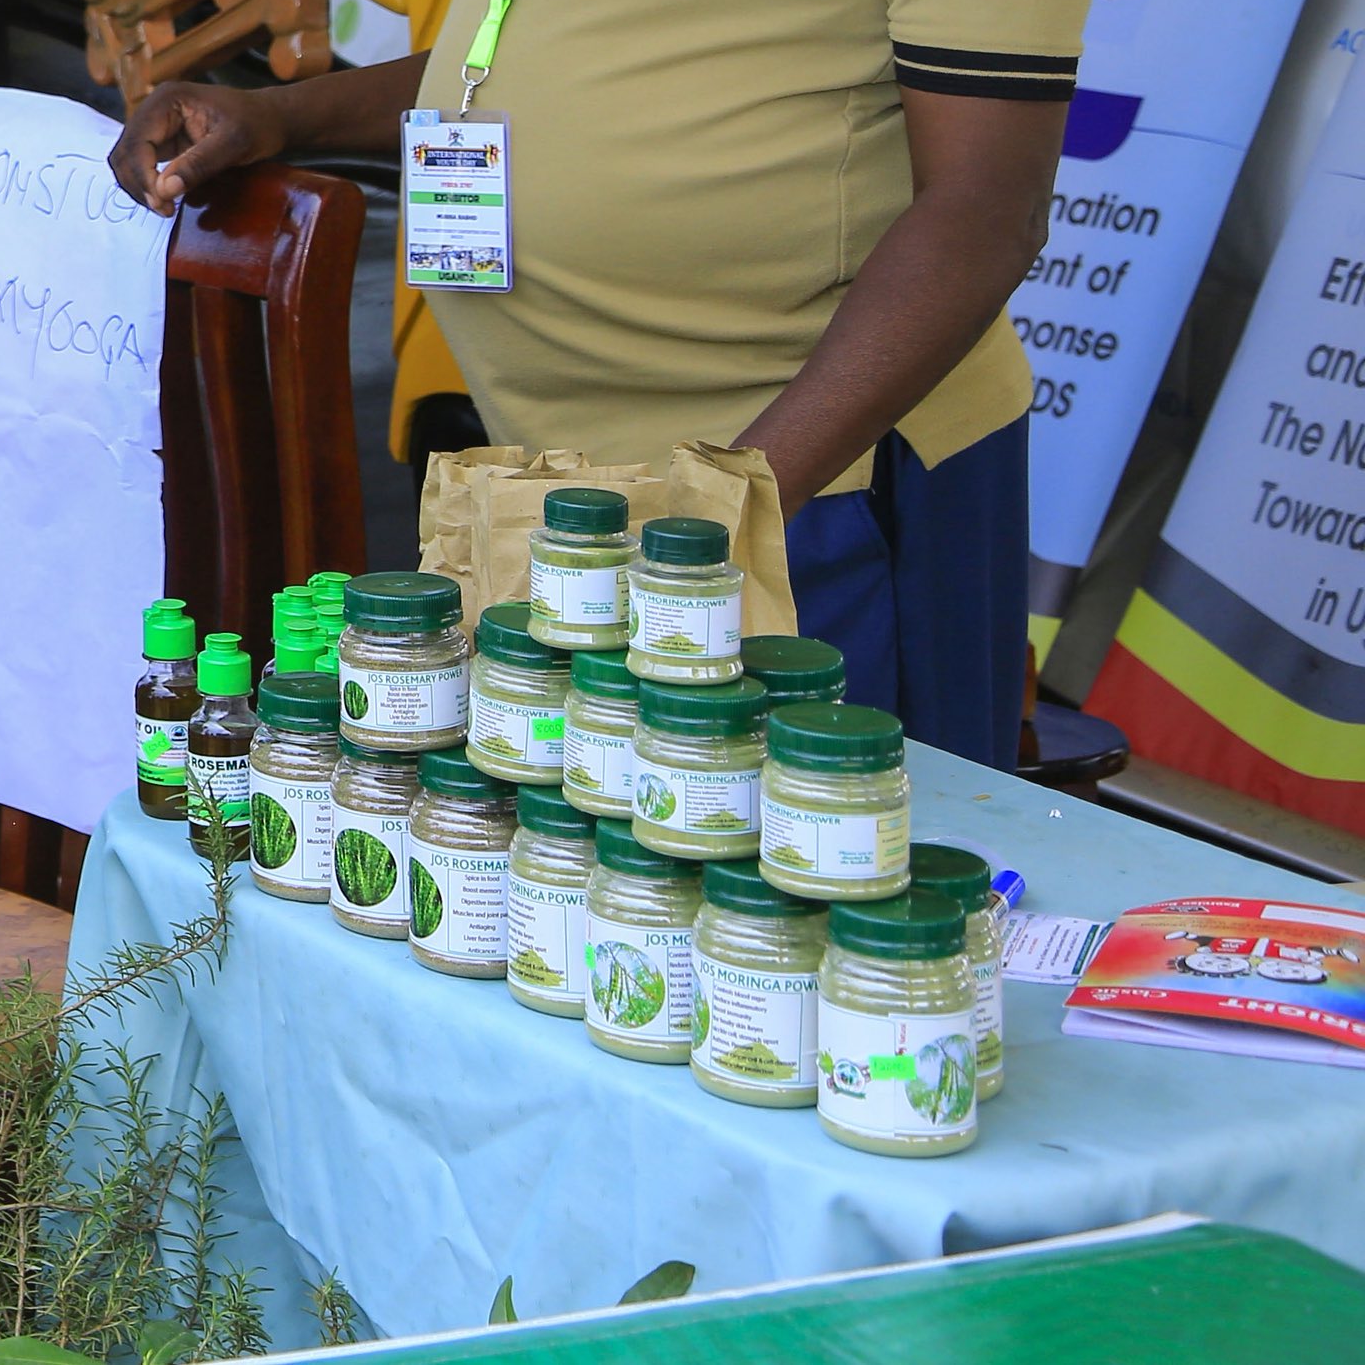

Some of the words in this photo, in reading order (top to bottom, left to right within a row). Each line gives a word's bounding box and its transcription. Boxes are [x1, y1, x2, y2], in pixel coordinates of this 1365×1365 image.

[1087, 260, 1131, 296] of
[1260, 401, 1325, 457] The
[647, 595, 694, 608] MORINGA
[696, 600, 728, 609] POWER
[1305, 577, 1338, 626] in
[367, 673, 384, 684] JOS
[385, 673, 437, 685] ROSEMARY
[438, 668, 463, 681] POWER
[515, 708, 549, 718] POWER
[670, 771, 687, 781] JOS
[689, 775, 738, 784] MORINGA
[283, 787, 303, 800] JOS
[380, 820, 402, 833] JOS
[804, 814, 841, 825] POWER
[430, 852, 450, 868] JOS
[645, 933, 669, 948] JOS
[699, 959, 716, 976] JOS
[717, 968, 782, 992] MORINGA
